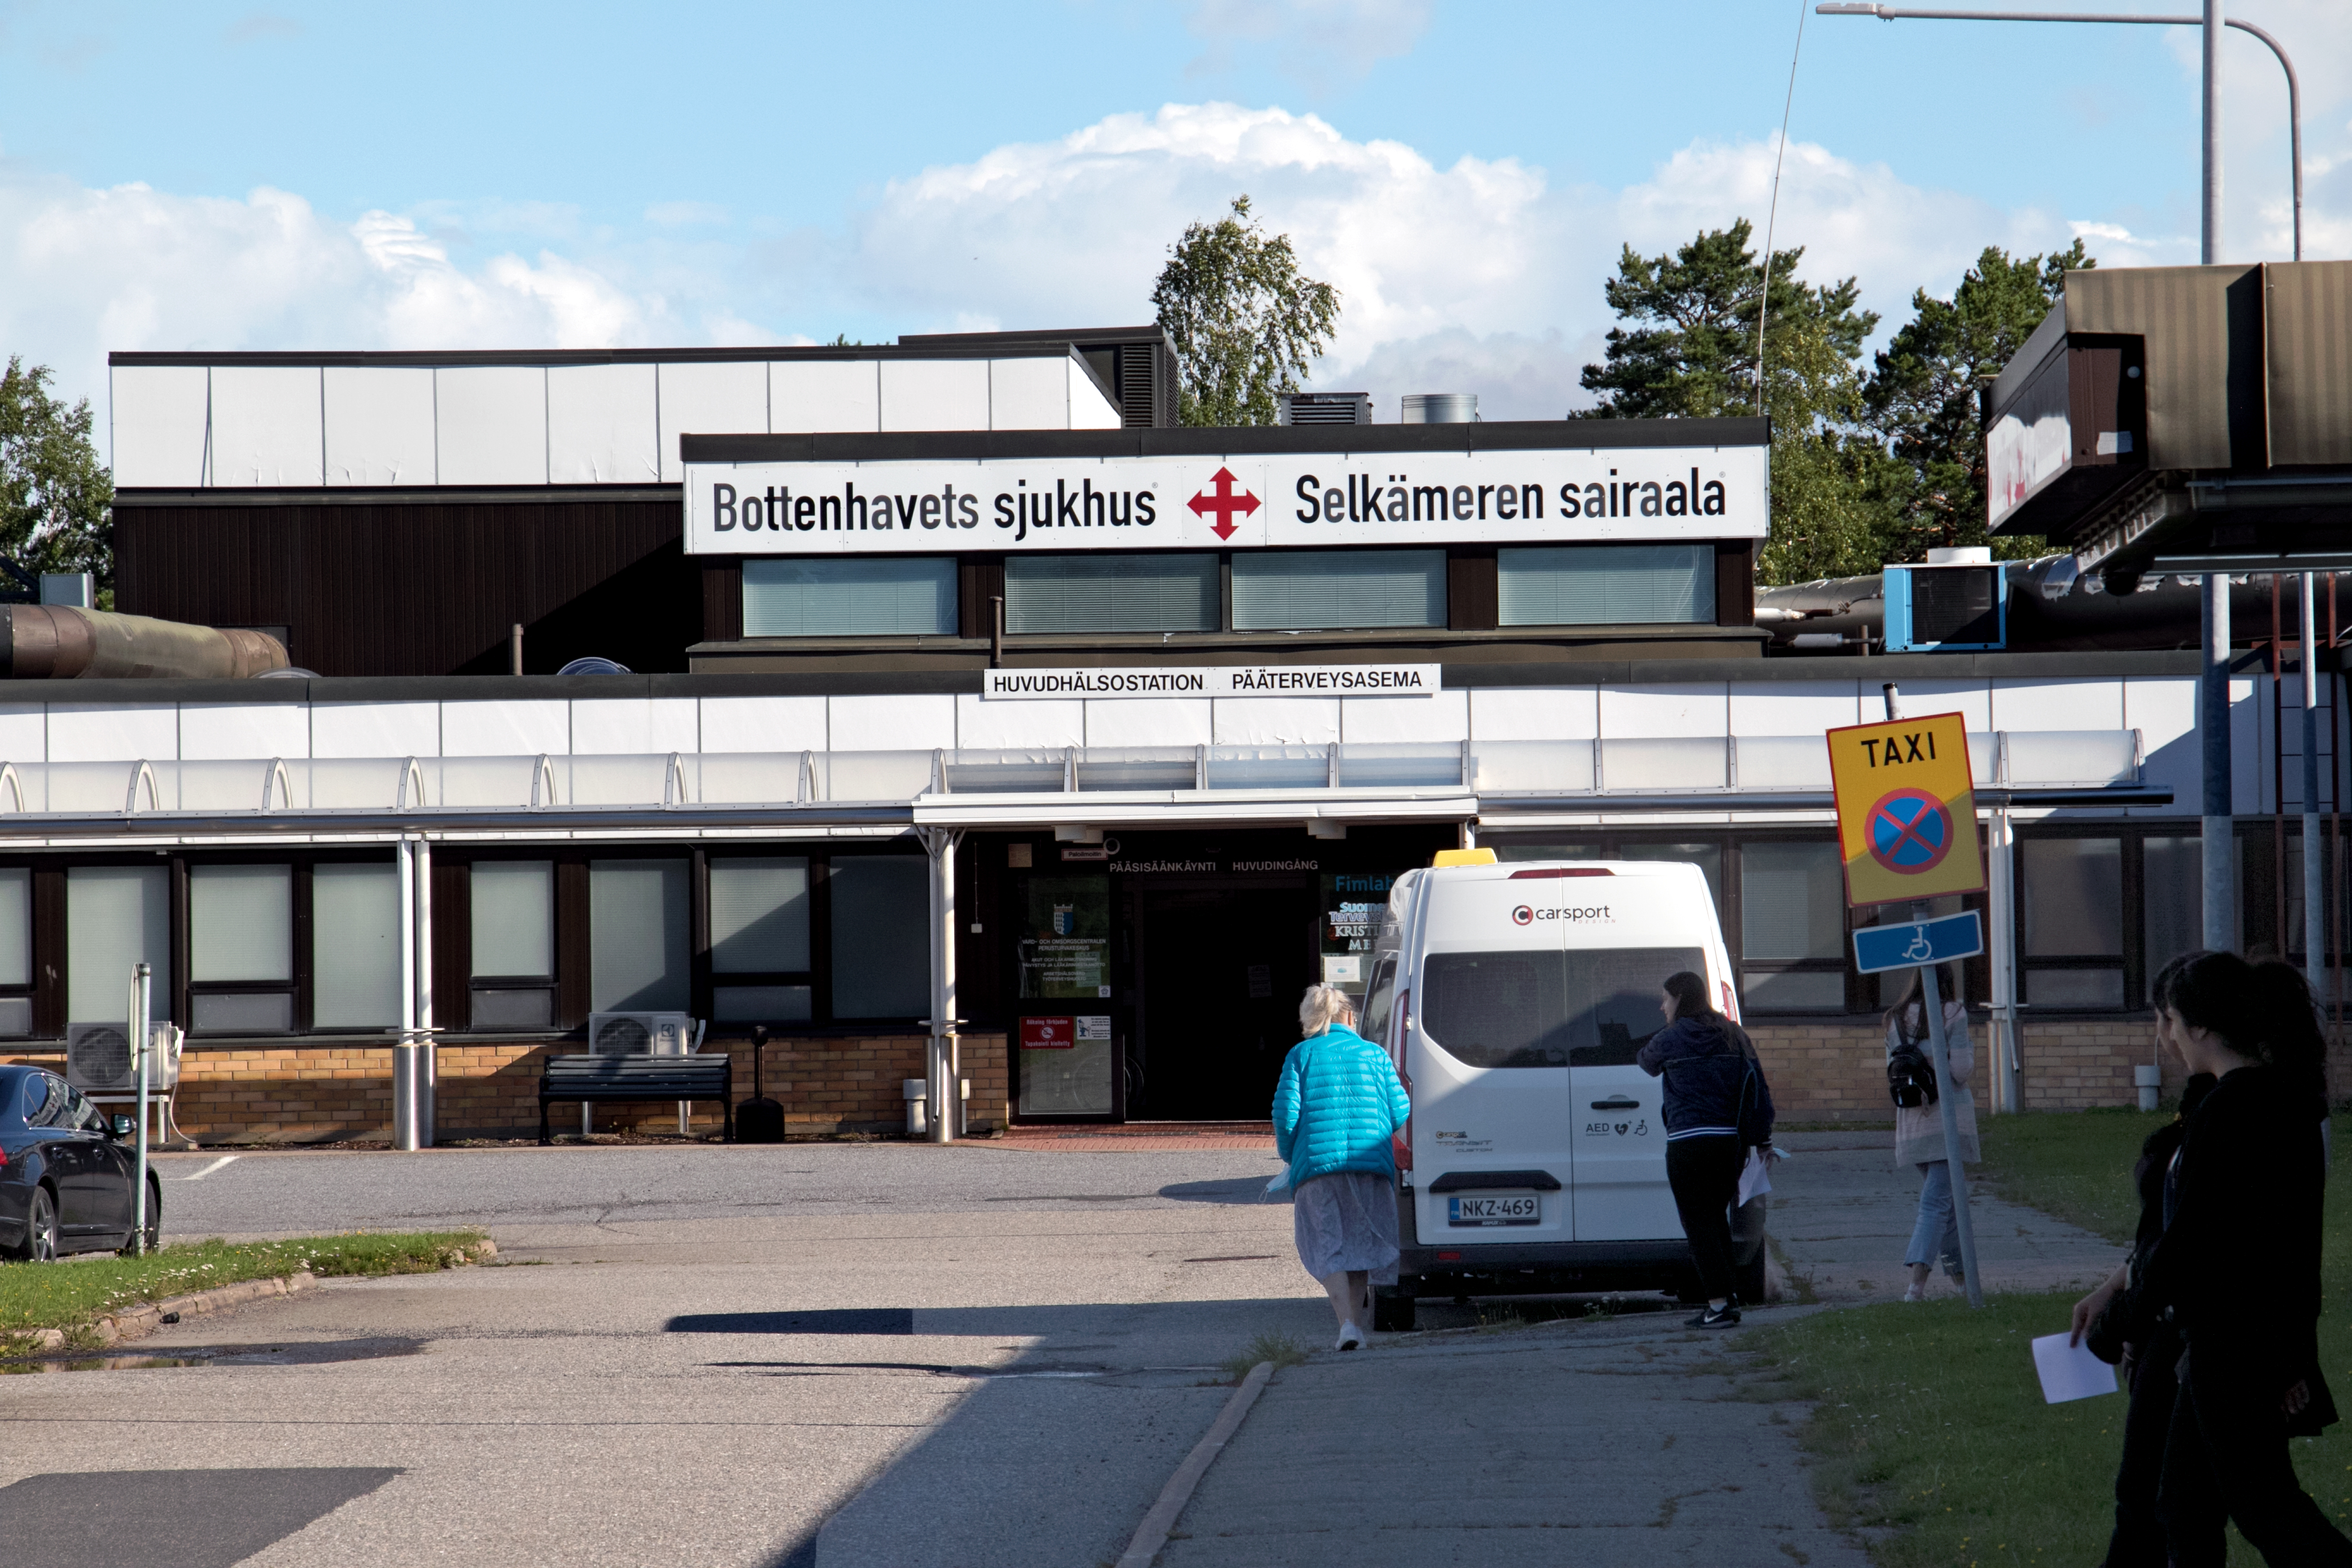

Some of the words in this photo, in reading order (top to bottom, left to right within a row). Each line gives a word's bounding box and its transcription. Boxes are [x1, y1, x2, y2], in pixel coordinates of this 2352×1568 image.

[713, 481, 979, 532] Bottenhavets
[1295, 473, 1543, 524] Selkämeren
[993, 671, 1204, 692] HUVUDHÄLSOSTATION
[1232, 669, 1422, 690] PÄÄTERVEYSASEMA
[1860, 731, 1937, 768] TAXI
[1110, 860, 1216, 872] PÄÄSISÄÄNKÄYNTI
[1233, 858, 1318, 871] HUVUDINGÅNG
[1339, 901, 1385, 913] Suome
[1535, 905, 1610, 922] carsport
[1334, 925, 1379, 937] KRISTI
[1586, 1123, 1610, 1132] AED
[1463, 1199, 1534, 1216] NKZ-469
